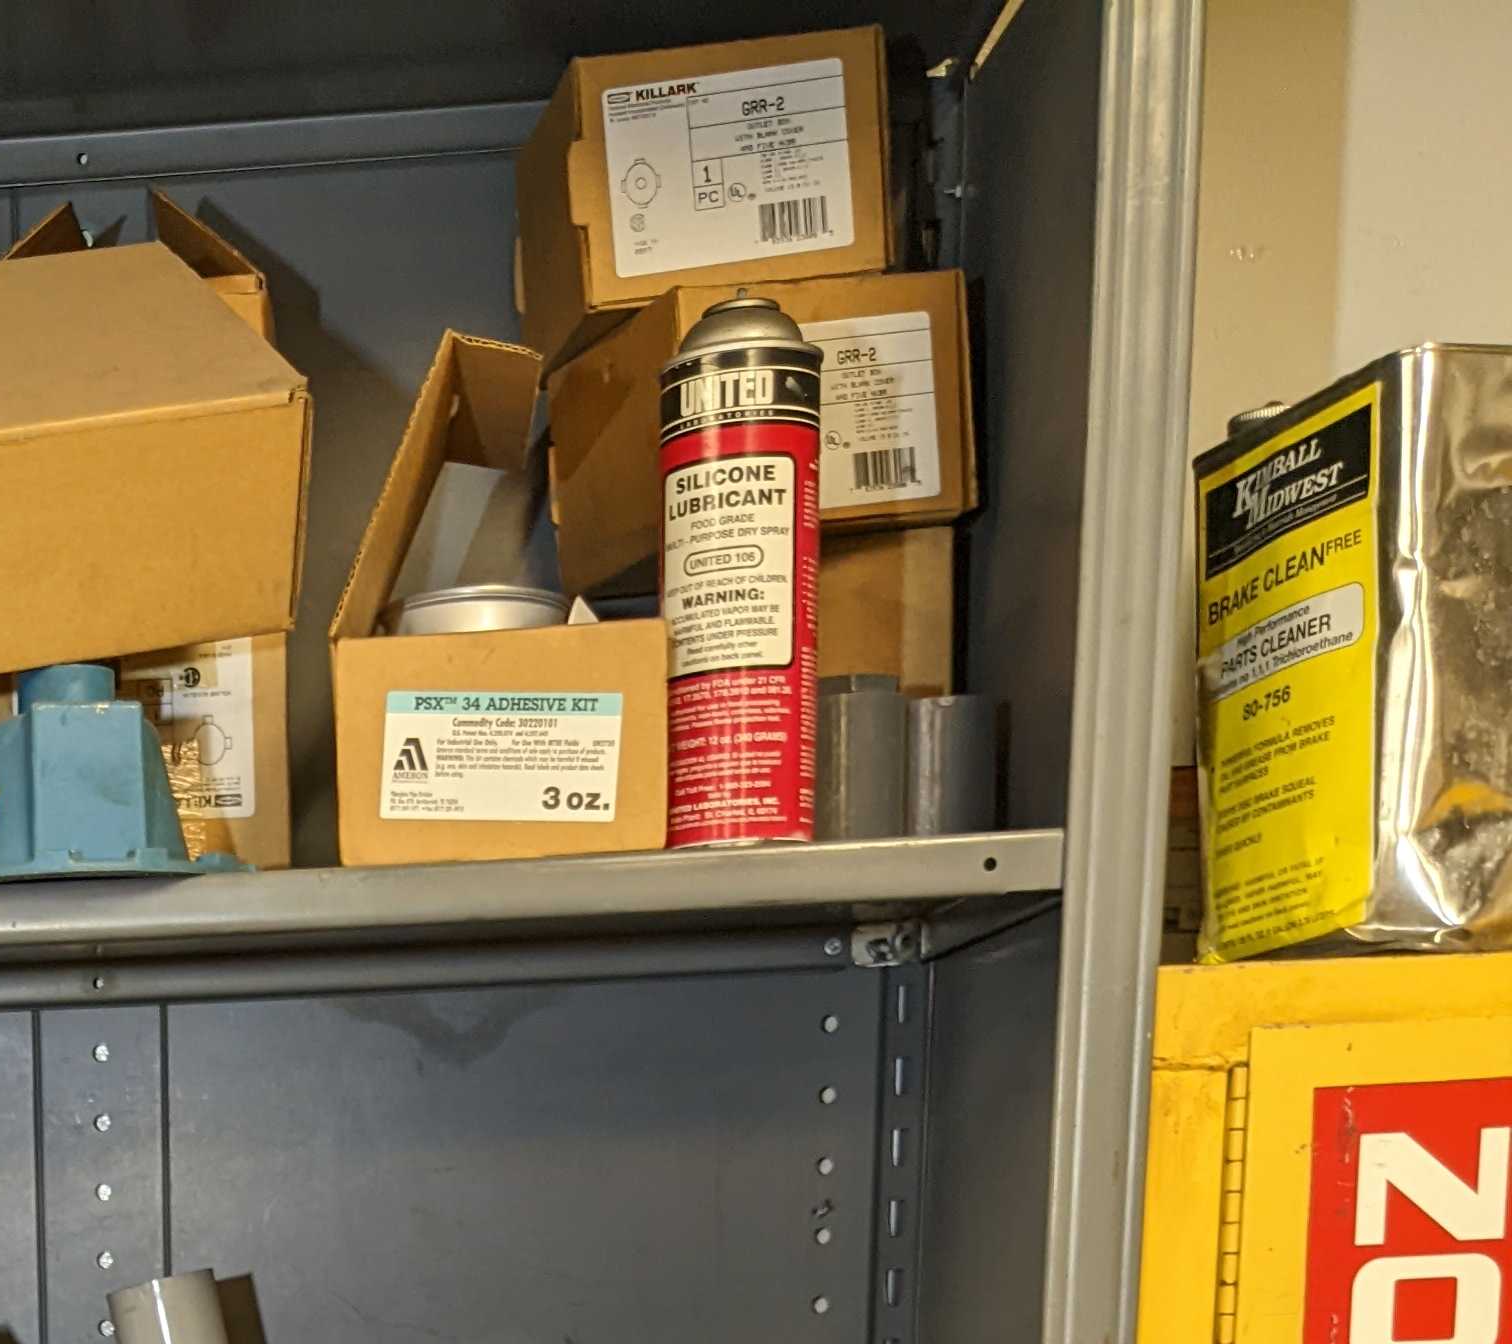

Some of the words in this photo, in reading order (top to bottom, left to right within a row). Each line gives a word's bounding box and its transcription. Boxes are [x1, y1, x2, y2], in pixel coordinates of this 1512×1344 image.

[635, 82, 697, 101] KILLARK
[742, 97, 785, 116] GRR-2
[703, 166, 711, 183] 1
[697, 190, 720, 204] PC
[837, 347, 877, 365] GRR-2
[680, 370, 774, 417] UNITED
[676, 465, 776, 495] SILICONE
[1233, 438, 1322, 519] KIMBALL
[669, 488, 787, 521] LUBRICANT
[1246, 460, 1344, 530] MIDWEST
[690, 515, 717, 531] FOOD
[719, 513, 755, 527] GRADE
[738, 527, 757, 537] DRY
[760, 526, 790, 536] SPRAY
[690, 553, 732, 570] UNITED
[735, 551, 756, 563] 106
[682, 588, 765, 610] WARNING:
[1208, 577, 1259, 626] BRAKE
[1221, 645, 1257, 679] PARTS
[1260, 613, 1331, 658] CLEANER
[1272, 630, 1354, 670] Trichloroethane
[462, 697, 481, 711] 34
[487, 697, 566, 712] ADHESIVE
[571, 697, 599, 712] KIT
[452, 717, 493, 729] Commodity
[1292, 715, 1335, 737] REMOVES
[1298, 730, 1330, 749] BRAKE
[542, 786, 561, 811] 3
[566, 791, 610, 811] oz.
